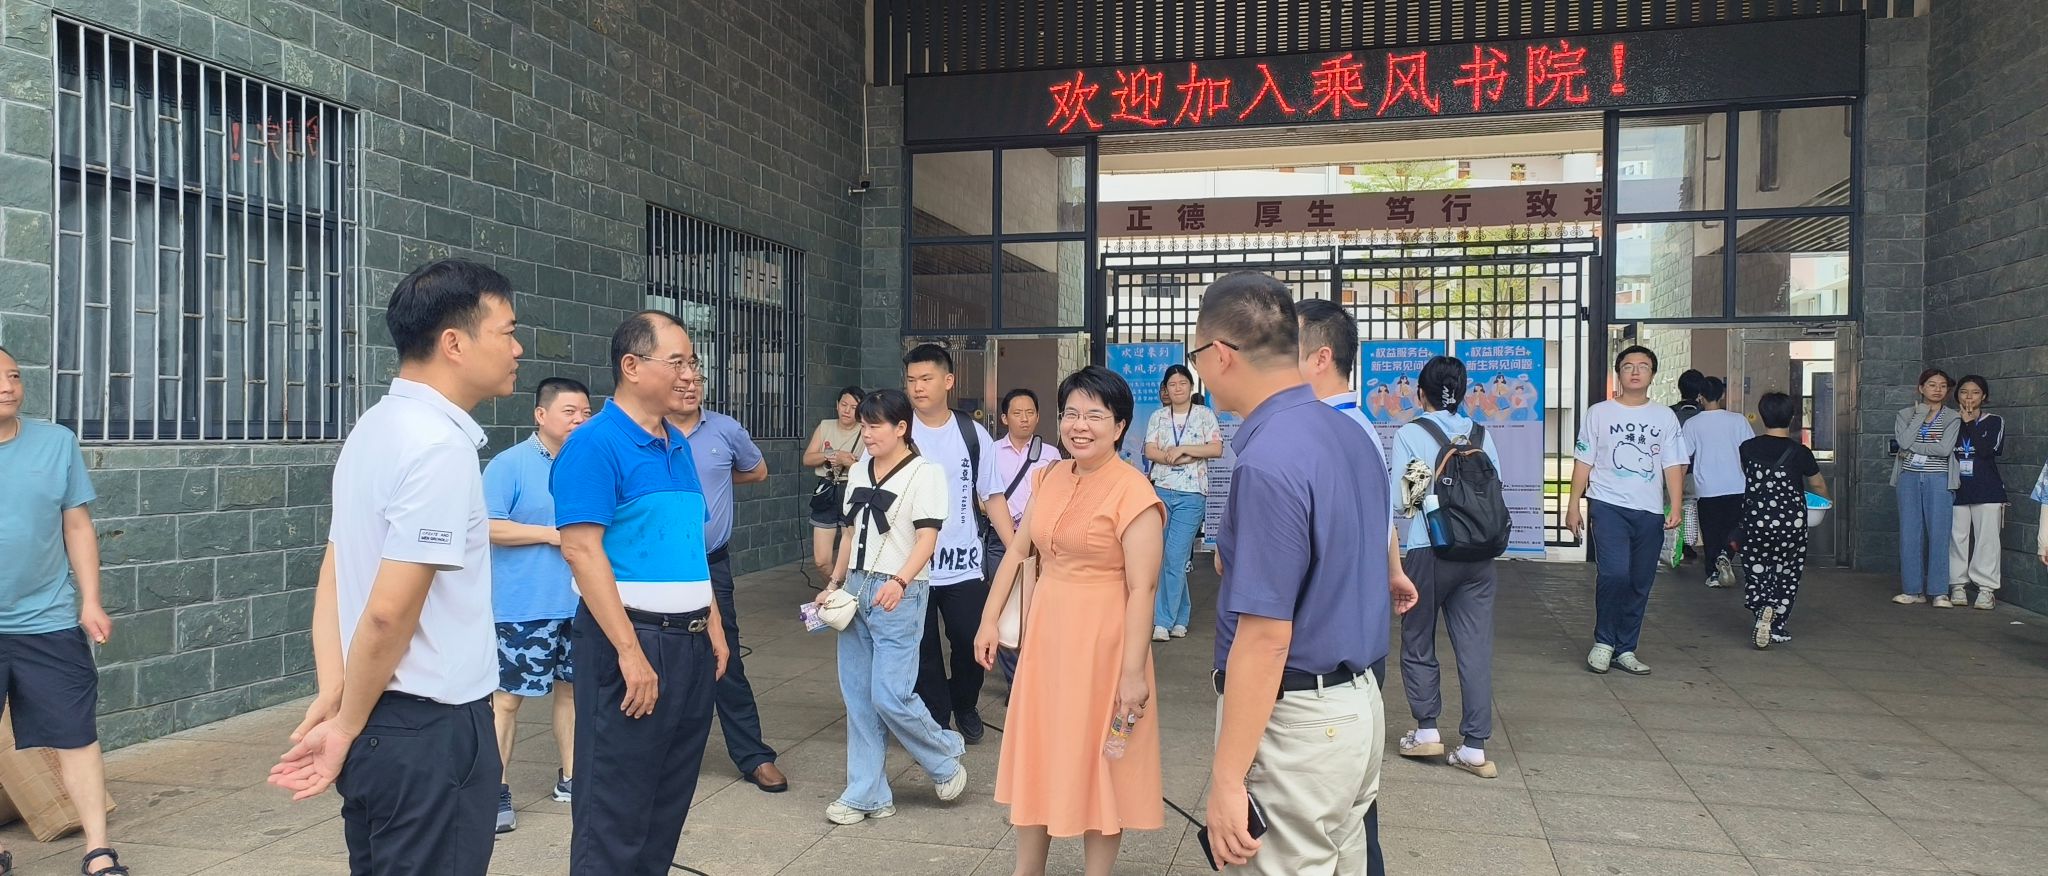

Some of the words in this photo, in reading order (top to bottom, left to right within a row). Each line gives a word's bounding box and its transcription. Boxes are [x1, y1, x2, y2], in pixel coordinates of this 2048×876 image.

[1048, 40, 1626, 133] 欢迎加入乘风书院！
[1126, 203, 1206, 231] 正德
[1254, 199, 1336, 228] 厚生
[1385, 194, 1472, 224] 笃行
[1375, 347, 1428, 359] 权益服务台
[1470, 345, 1526, 357] 权益服务台
[1371, 360, 1428, 372] 新生常见问
[1466, 358, 1533, 371] 新生常见问题
